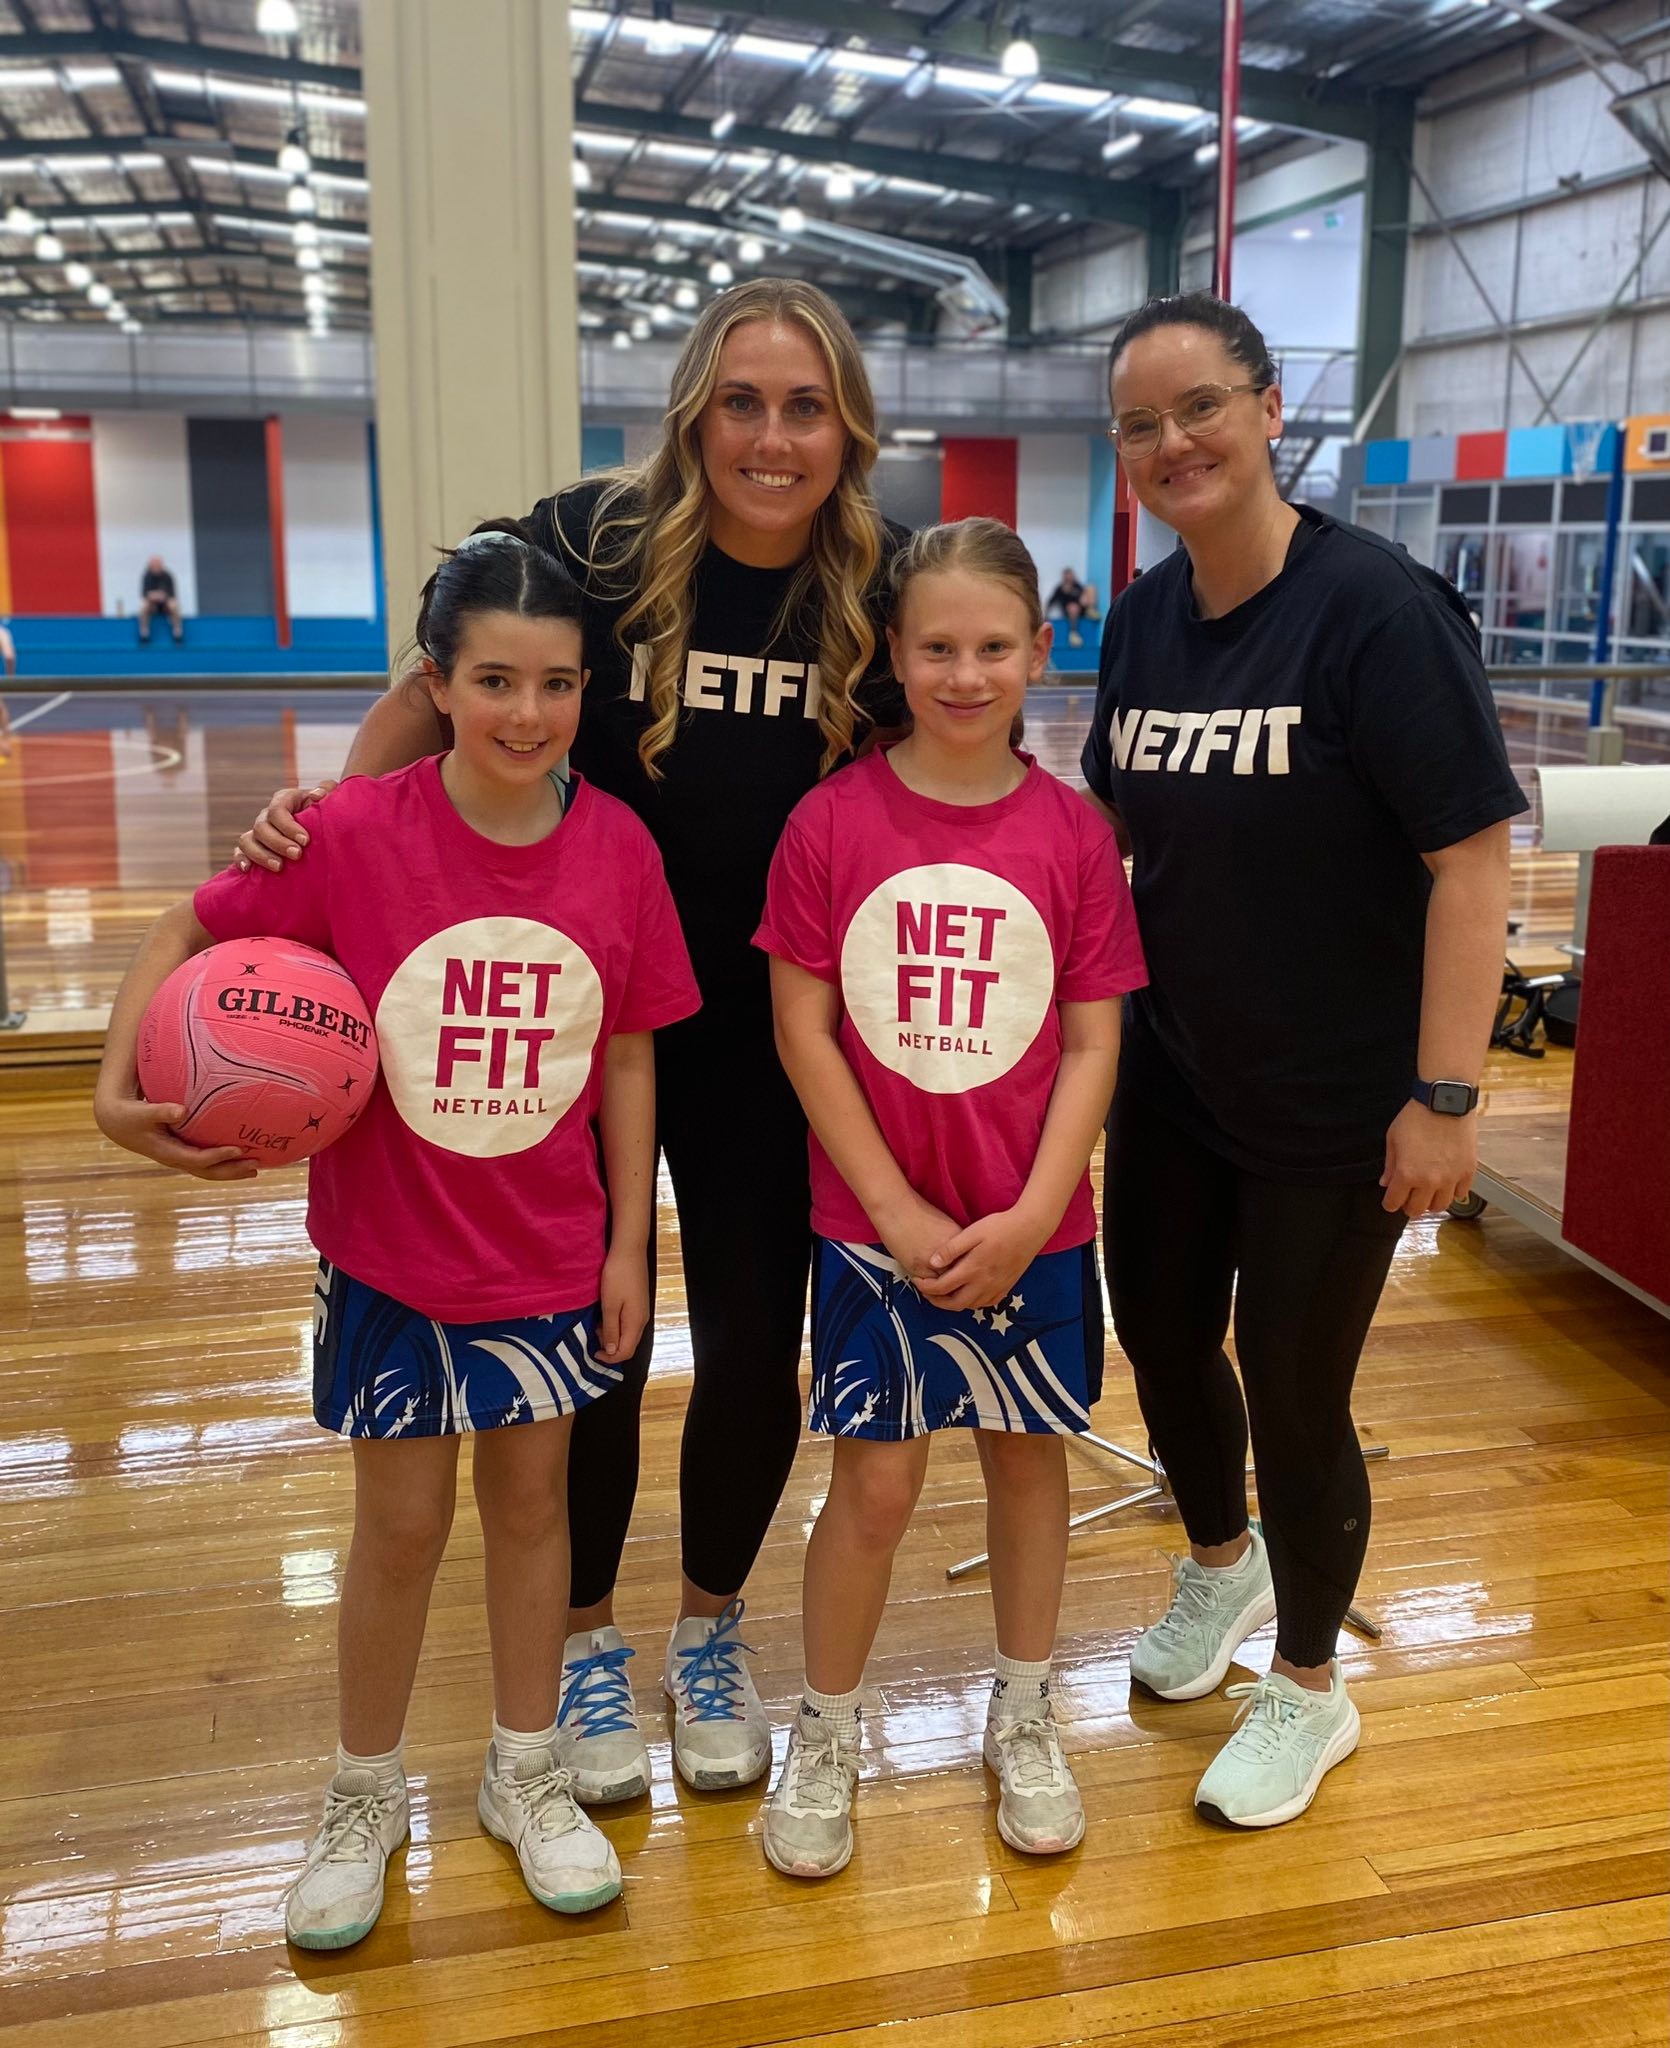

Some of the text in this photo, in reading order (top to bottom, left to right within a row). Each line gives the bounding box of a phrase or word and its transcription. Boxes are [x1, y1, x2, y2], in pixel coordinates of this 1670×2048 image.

[1109, 706, 1302, 775] NETFIT
[896, 901, 1007, 962] NET
[217, 987, 372, 1049] GILBERT
[441, 958, 562, 1019] NET
[897, 964, 1000, 1029] FIT
[279, 1018, 330, 1038] PHOENIX
[435, 1025, 555, 1089] FIT
[898, 1032, 993, 1055] NETBALL
[433, 1098, 547, 1116] NETBALL
